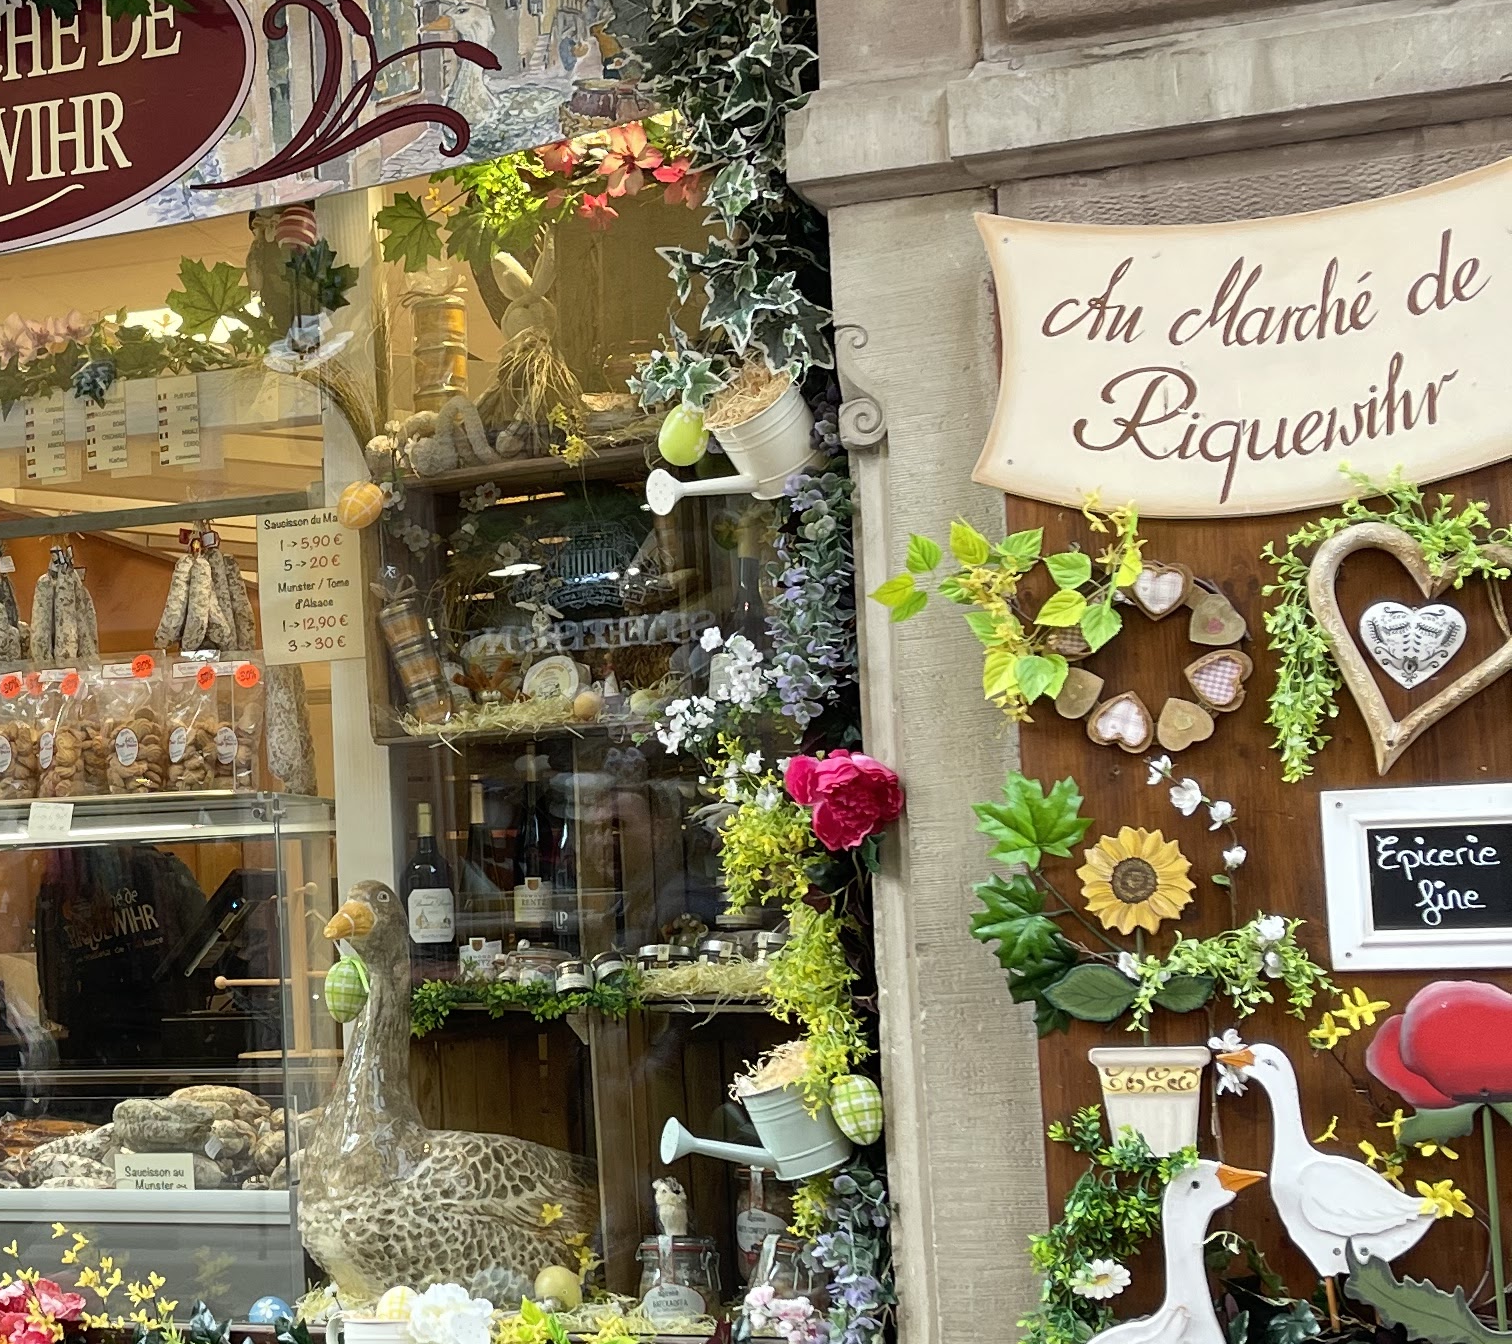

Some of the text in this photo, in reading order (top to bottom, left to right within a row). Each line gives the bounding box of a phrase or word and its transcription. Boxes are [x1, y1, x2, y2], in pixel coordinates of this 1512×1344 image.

[1041, 228, 1492, 347] Au Marché de
[1073, 351, 1459, 505] Riquewihr
[264, 518, 309, 530] Saucisson
[311, 514, 321, 524] du
[300, 534, 331, 551] 5,90
[333, 533, 343, 546] €
[284, 554, 341, 572] 5 20 €
[278, 582, 316, 593] Munster
[327, 578, 349, 589] Tome
[295, 598, 334, 610] d'Alsace
[302, 615, 337, 632] 12,90
[339, 614, 349, 627] €
[288, 635, 347, 652] 3 30 €
[1375, 834, 1501, 881] Epicerie
[1414, 879, 1487, 926] fine
[125, 1165, 185, 1177] Saucisson au
[135, 1179, 174, 1190] Munster
